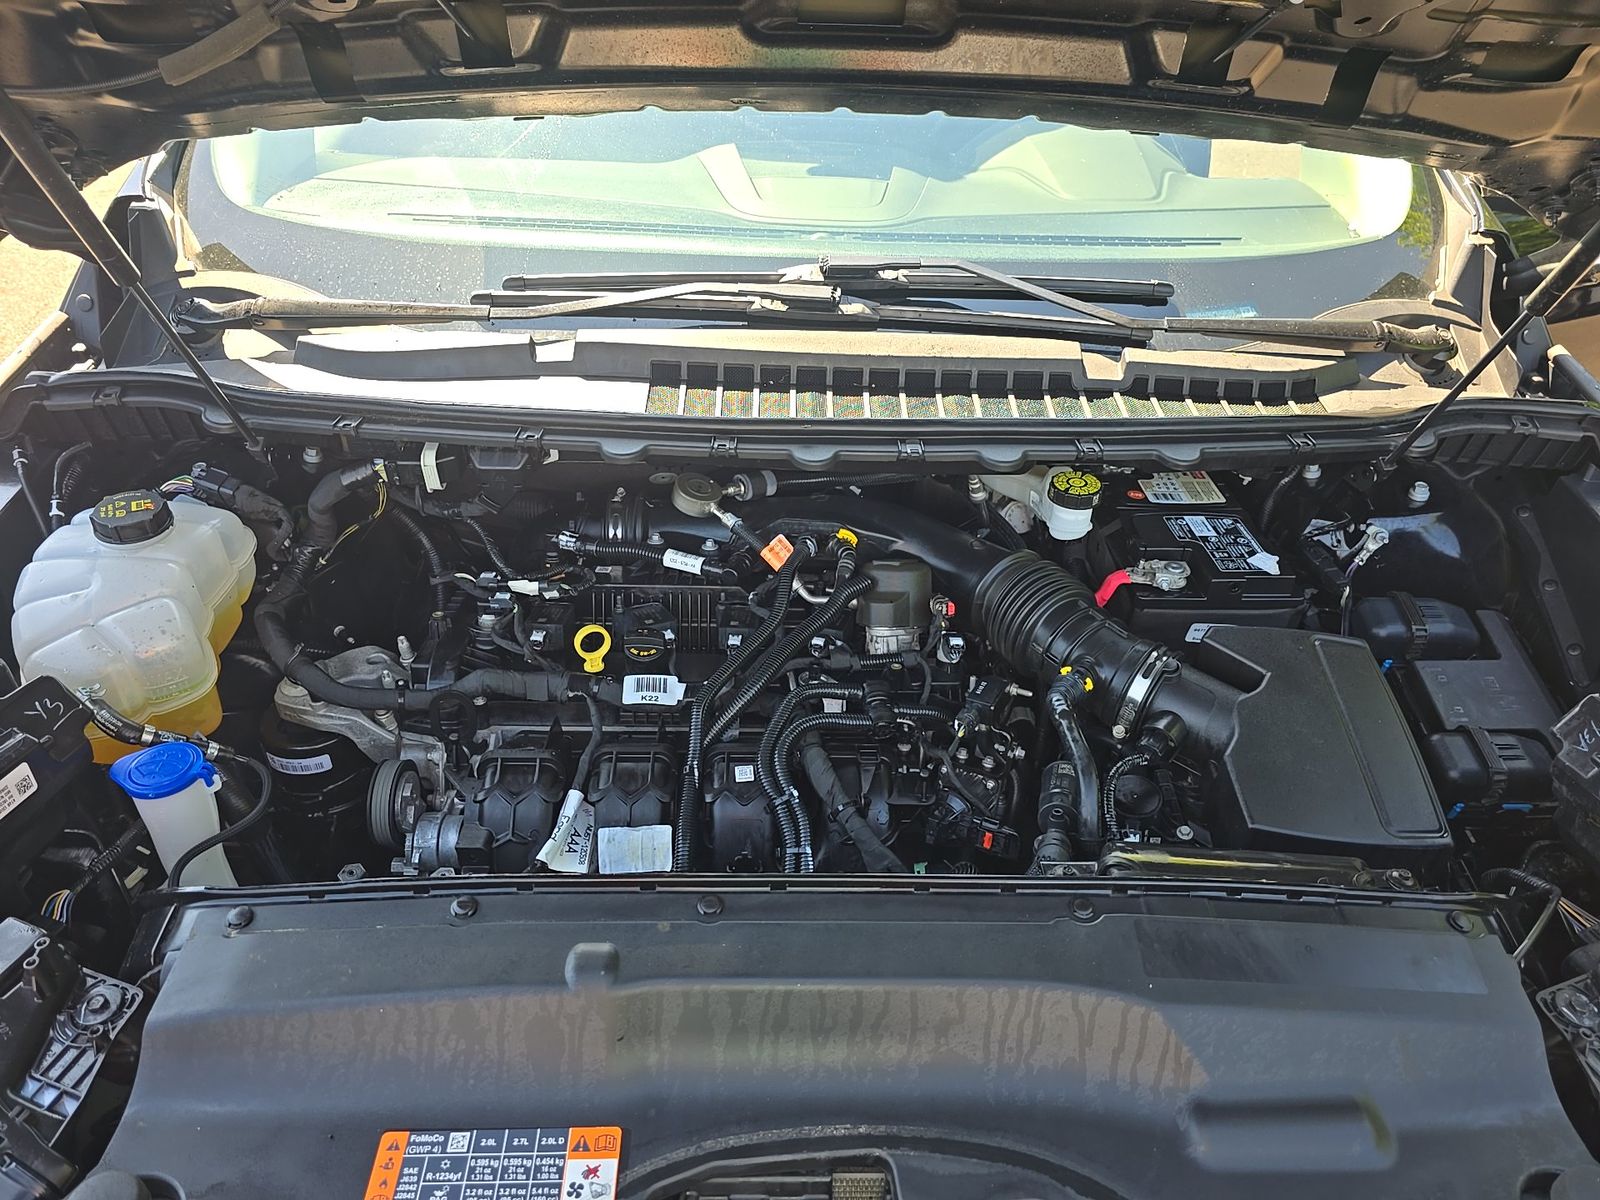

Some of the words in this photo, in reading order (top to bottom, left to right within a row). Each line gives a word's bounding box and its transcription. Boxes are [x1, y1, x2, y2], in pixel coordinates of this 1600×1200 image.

[641, 694, 659, 702] K22
[565, 826, 582, 853] AAA
[410, 1134, 445, 1142] FoMoCo
[480, 1138, 496, 1146] 2.0L
[540, 1137, 557, 1145] 2.0L
[405, 1145, 431, 1154] (GWP
[432, 1145, 442, 1154] 4)
[470, 1158, 490, 1166] 0.595
[490, 1158, 499, 1168] kg
[503, 1158, 522, 1166] 0.595
[523, 1158, 532, 1167] kg
[535, 1157, 555, 1166] 0.454
[555, 1157, 564, 1167] kg
[426, 1172, 462, 1181] R-1234yf
[465, 1188, 477, 1196] 3.2
[531, 1187, 543, 1195] 5.4
